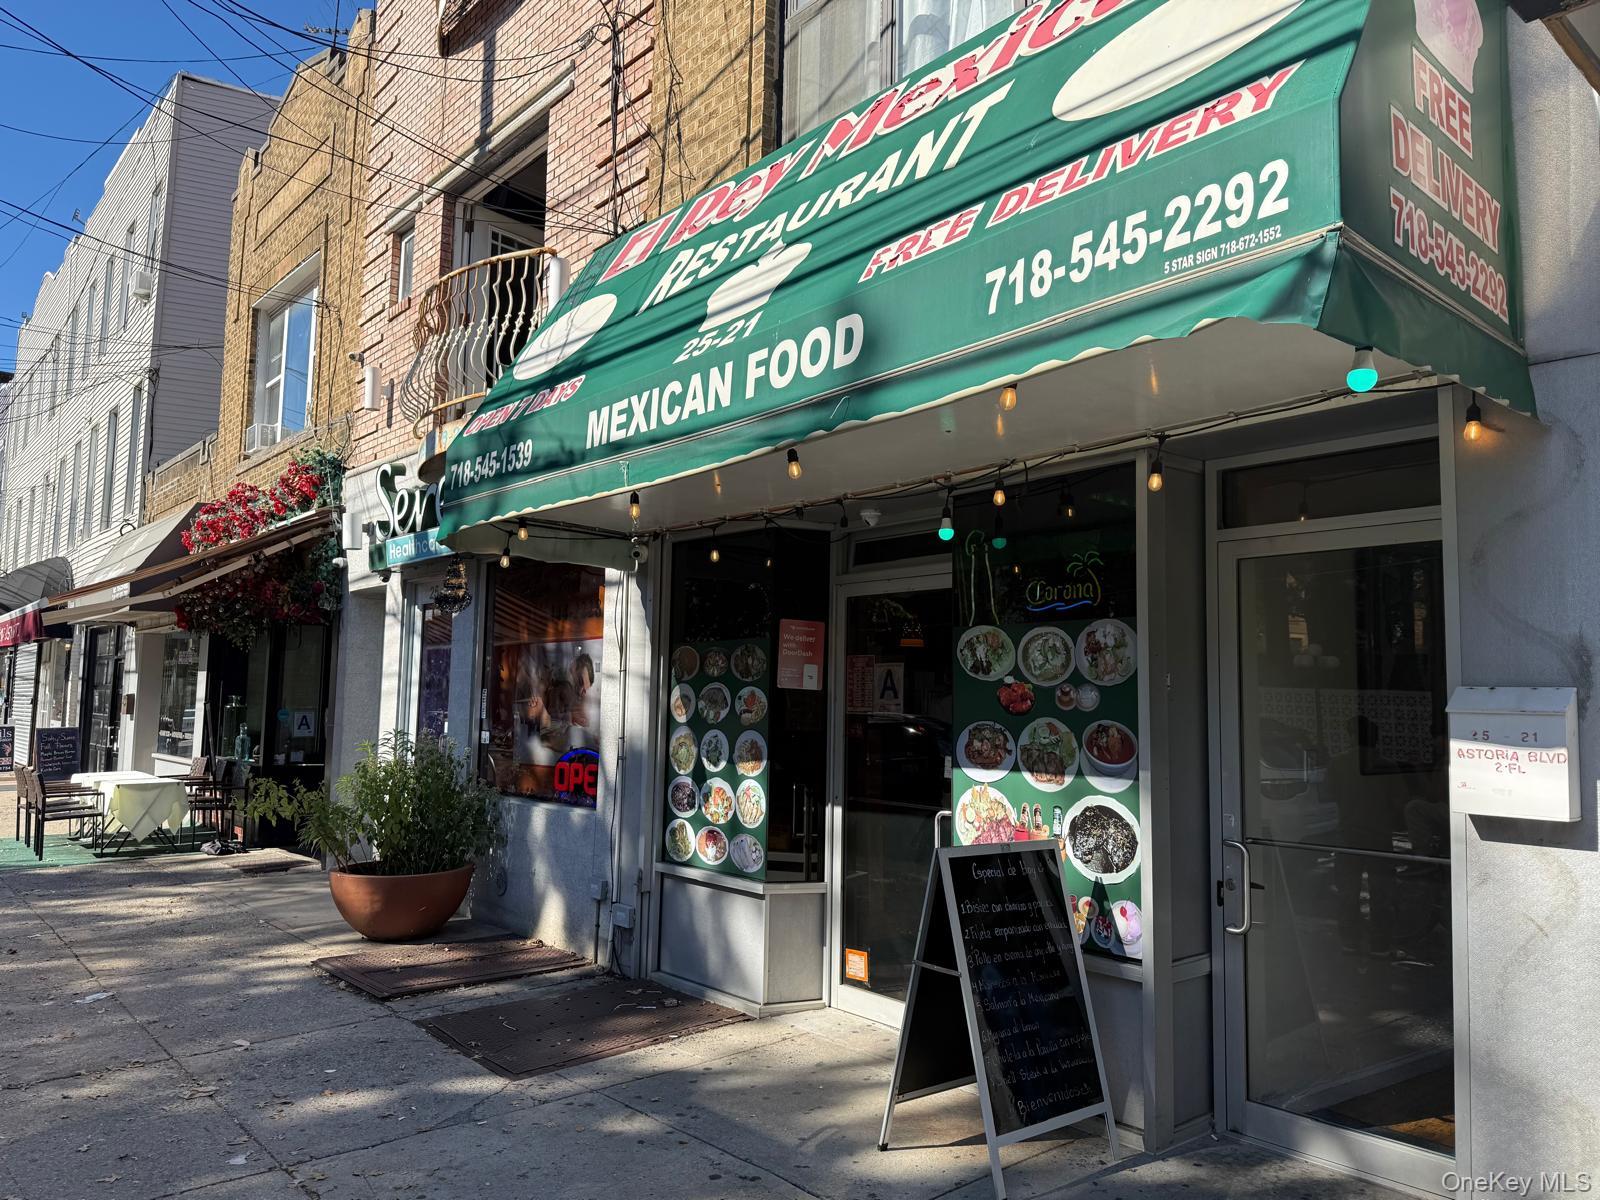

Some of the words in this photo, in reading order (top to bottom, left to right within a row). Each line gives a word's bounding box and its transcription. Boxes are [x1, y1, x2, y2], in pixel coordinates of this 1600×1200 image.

[797, 0, 1133, 182] Mexic
[1412, 46, 1474, 160] FREE
[636, 79, 1015, 316] RESTAURANT
[858, 203, 986, 283] FREE
[986, 61, 1304, 228] DELIVERY
[1390, 104, 1501, 255] DELIVERY
[986, 158, 1289, 314] 718-545-2292
[1164, 261, 1170, 274] 5
[1172, 254, 1194, 272] STAR
[1196, 248, 1218, 265] SIGN
[1220, 225, 1282, 257] 718-672-1552
[1390, 186, 1510, 326] 718-545-2292
[673, 311, 763, 364] 25-21
[463, 402, 517, 437] OPEN
[513, 393, 530, 420] 7
[527, 374, 586, 412] DAYS
[585, 360, 733, 449] MEXICAN
[744, 313, 864, 399] FOOD
[450, 439, 533, 491] 718-545-1539
[1025, 580, 1094, 606] Corona
[880, 669, 899, 699] A
[297, 715, 311, 730] A
[1521, 732, 1538, 743] 21
[553, 761, 598, 797] OPE
[1528, 751, 1567, 764] BLVD
